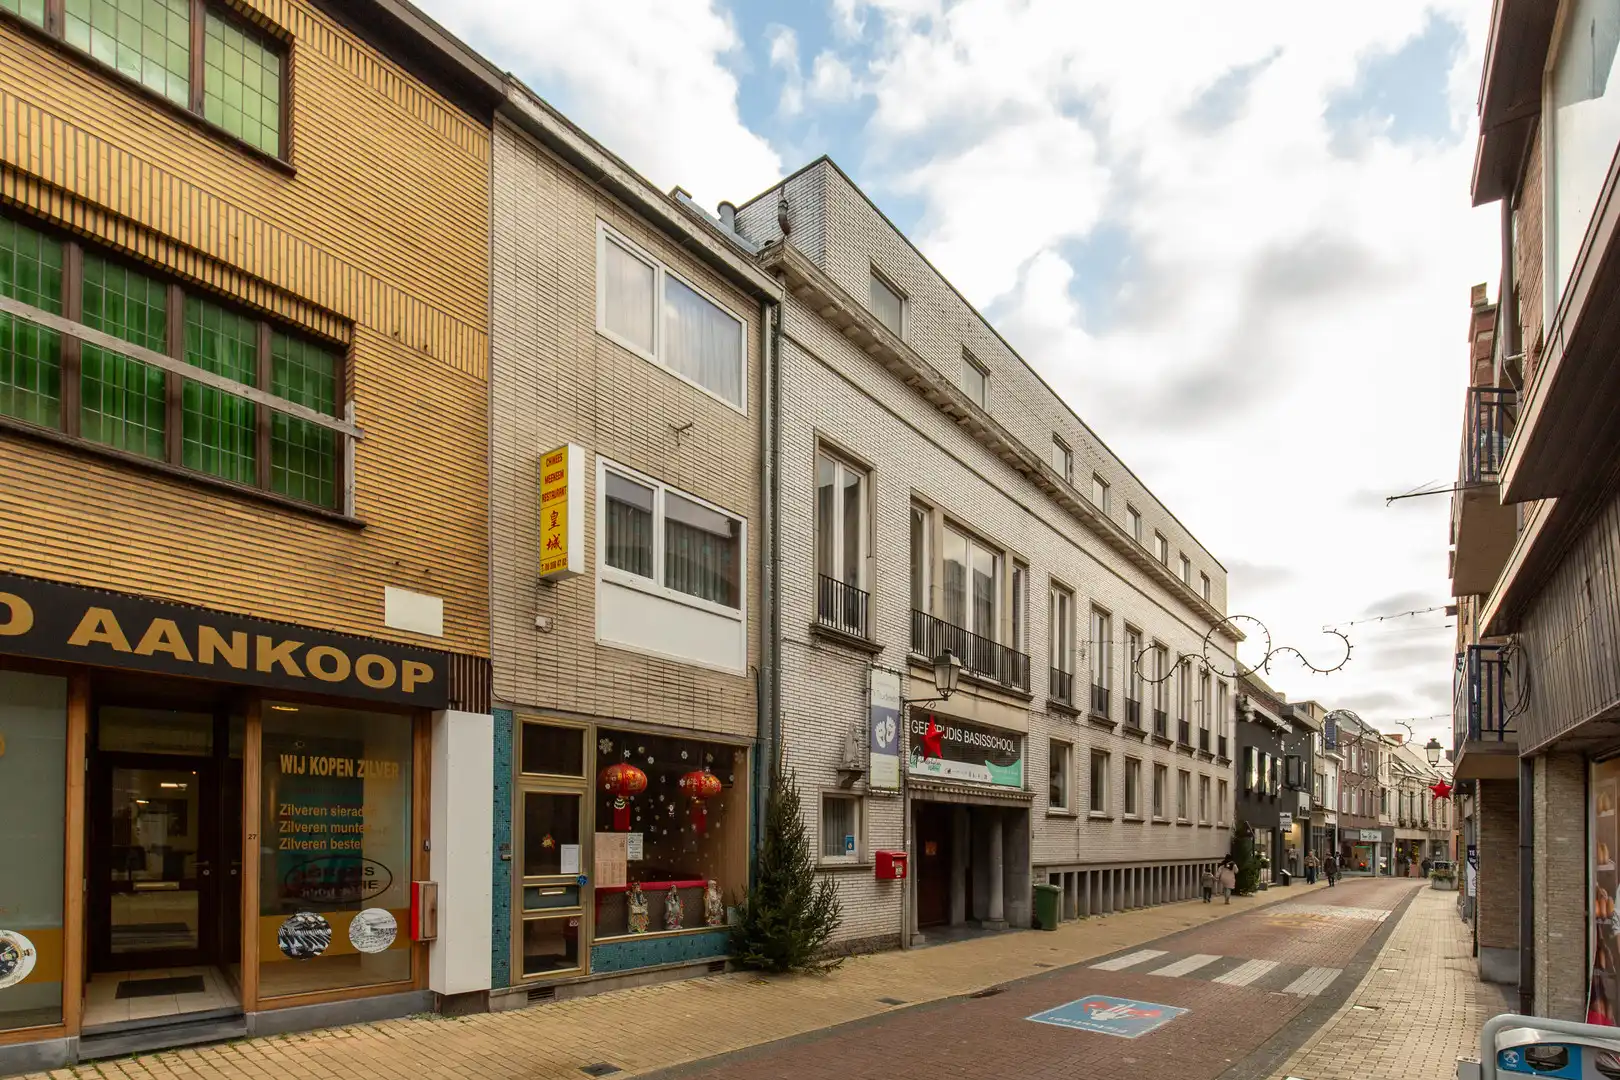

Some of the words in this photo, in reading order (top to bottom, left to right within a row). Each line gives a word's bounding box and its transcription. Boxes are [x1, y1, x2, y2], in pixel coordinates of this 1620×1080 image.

[546, 453, 562, 467] CHINEES
[542, 486, 566, 502] RESTAURANT
[547, 510, 562, 550] 皇城
[67, 607, 434, 693] AANKOOP
[964, 730, 1016, 752] BASISSCHOOL
[280, 754, 306, 775] WIJ
[309, 756, 354, 778] KOPEN
[357, 759, 399, 779] ZILVER
[279, 803, 327, 816] Zilveren
[279, 821, 327, 833] Zilveren
[279, 838, 327, 850] Zilveren
